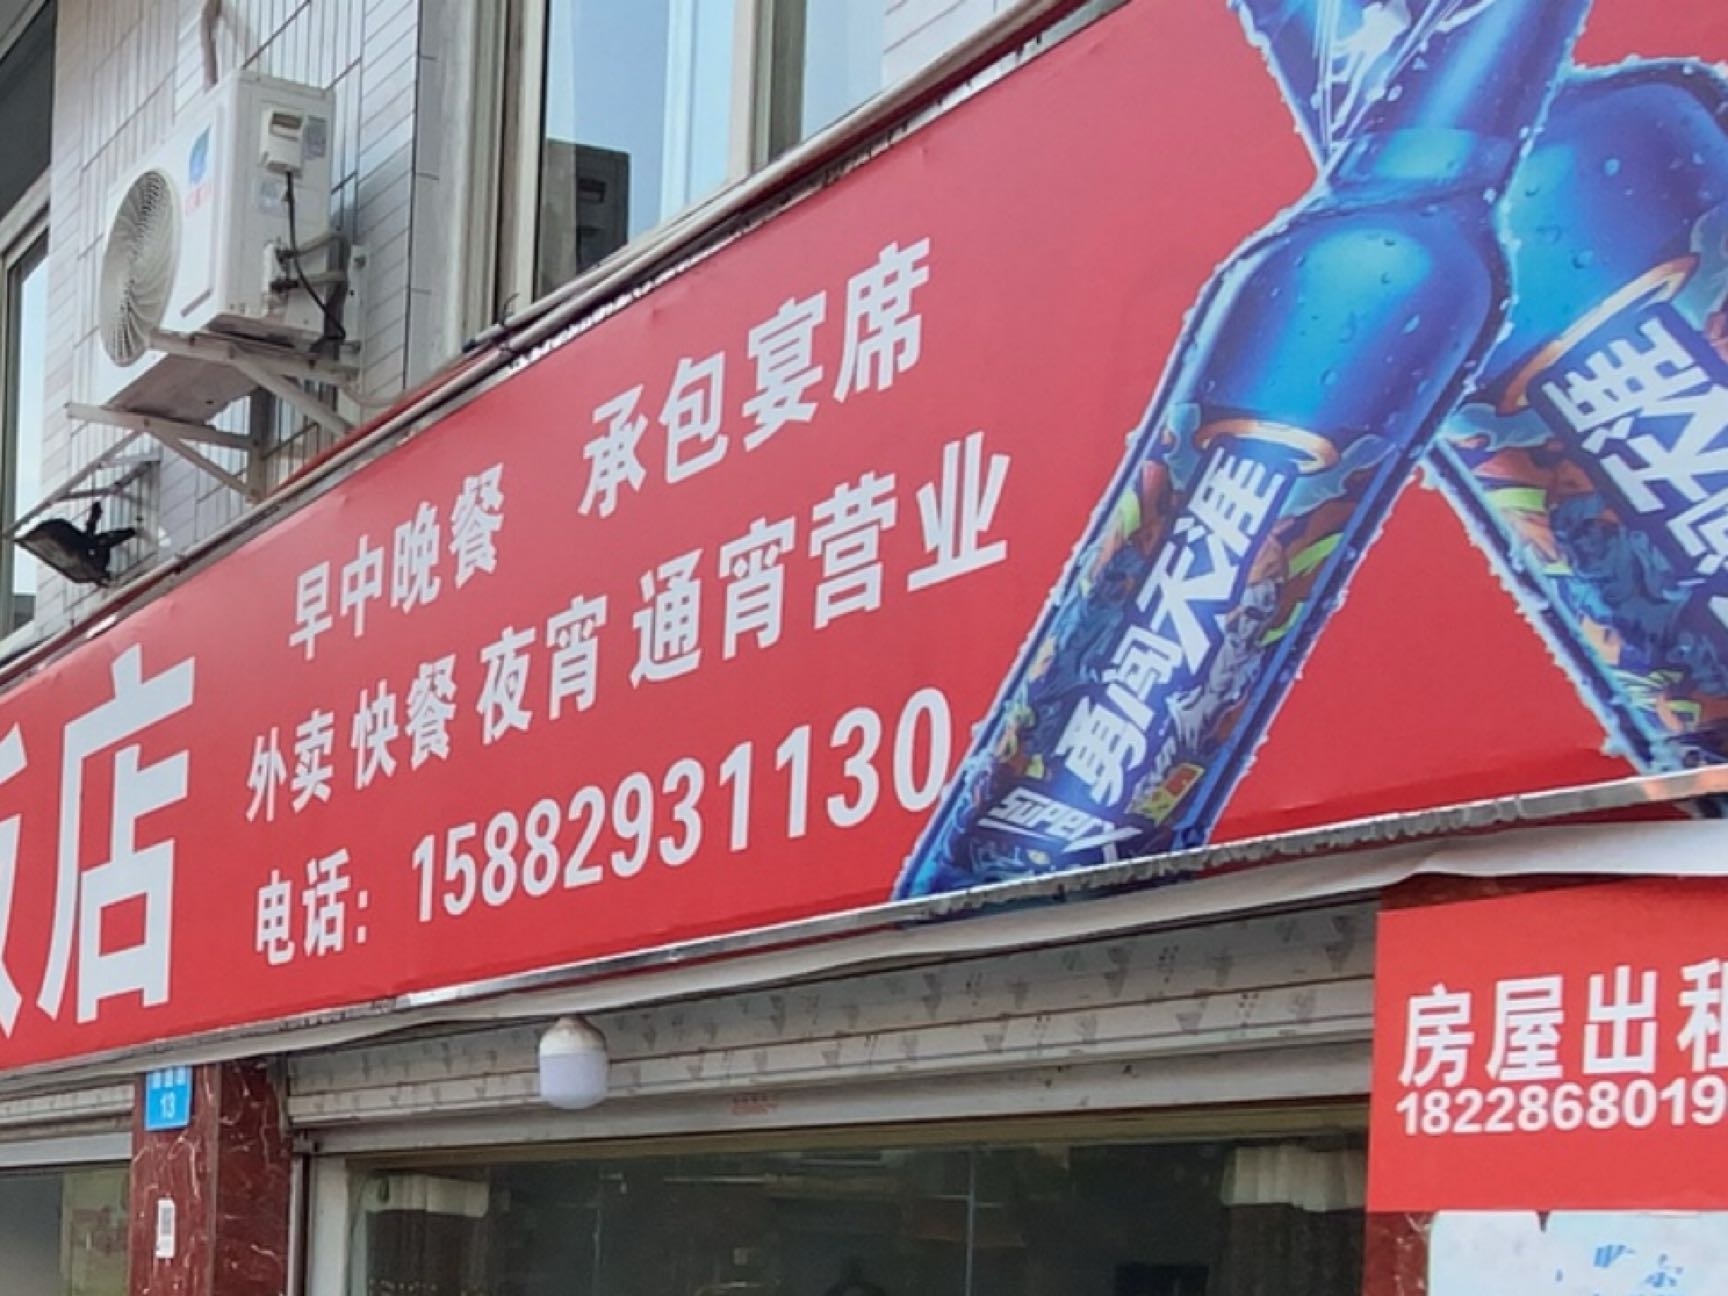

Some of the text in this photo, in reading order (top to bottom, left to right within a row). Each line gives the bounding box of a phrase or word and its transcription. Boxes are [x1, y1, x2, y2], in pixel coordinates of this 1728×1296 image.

[246, 431, 1011, 823] 外卖 快餐 夜宵 通宵营业
[289, 236, 931, 661] 早中晚餐 承包宴席
[1055, 443, 1285, 805] 勇闯天涯
[1395, 1073, 1728, 1138] 1822868019
[1397, 957, 1728, 1088] 房屋出租
